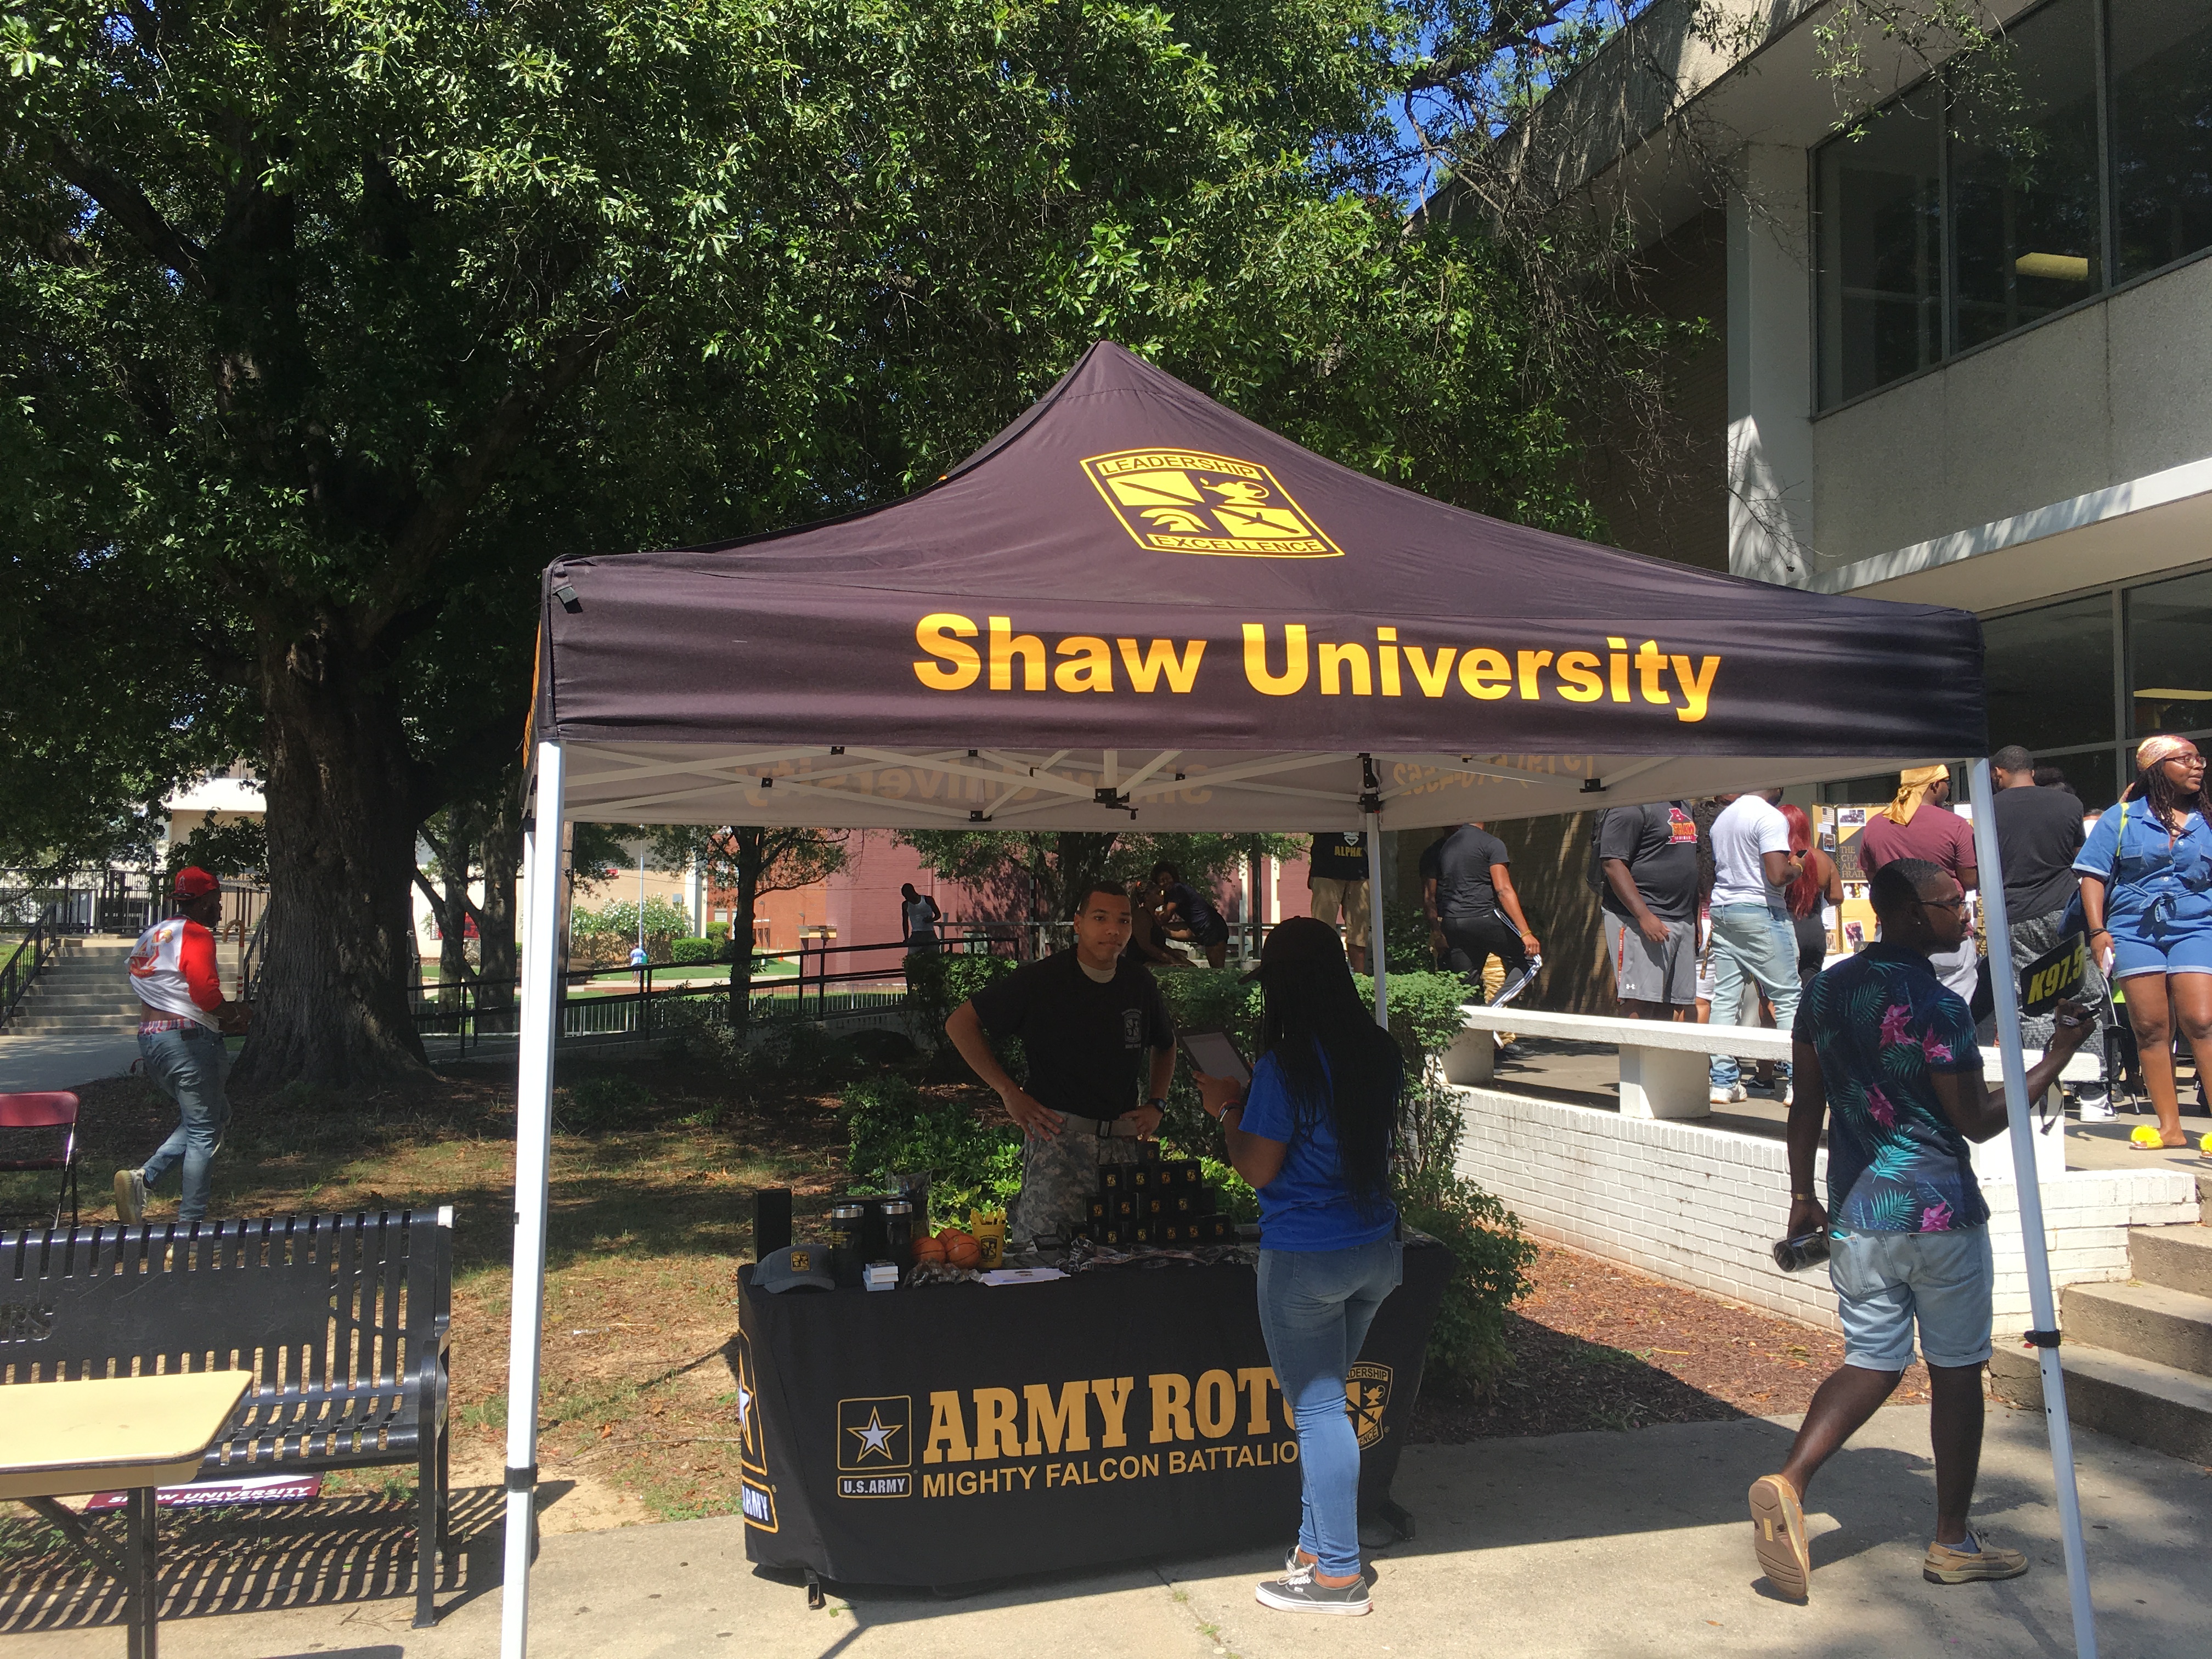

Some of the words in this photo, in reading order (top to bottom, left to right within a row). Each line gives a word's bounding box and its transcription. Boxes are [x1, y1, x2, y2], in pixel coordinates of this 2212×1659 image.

[1101, 455, 1255, 478] LEADERSHIP
[1154, 535, 1323, 552] EXCELLENCE
[913, 612, 1206, 693] Shaw
[1242, 623, 1721, 723] University
[1334, 845, 1363, 857] ALPHA
[1839, 845, 1855, 854] THE
[1842, 862, 1858, 870] ALP
[2027, 942, 2084, 1005] K97.5
[1347, 1368, 1387, 1380] DERSHIP
[923, 1376, 1134, 1464] ARMY
[923, 1465, 1037, 1498] MIGHTY
[1046, 1453, 1160, 1487] FALCON
[1169, 1441, 1299, 1475] BATTALIO
[108, 1494, 179, 1502] SW
[182, 1487, 312, 1499] UNIVERSITY
[171, 1493, 307, 1505] BOOKSTORE
